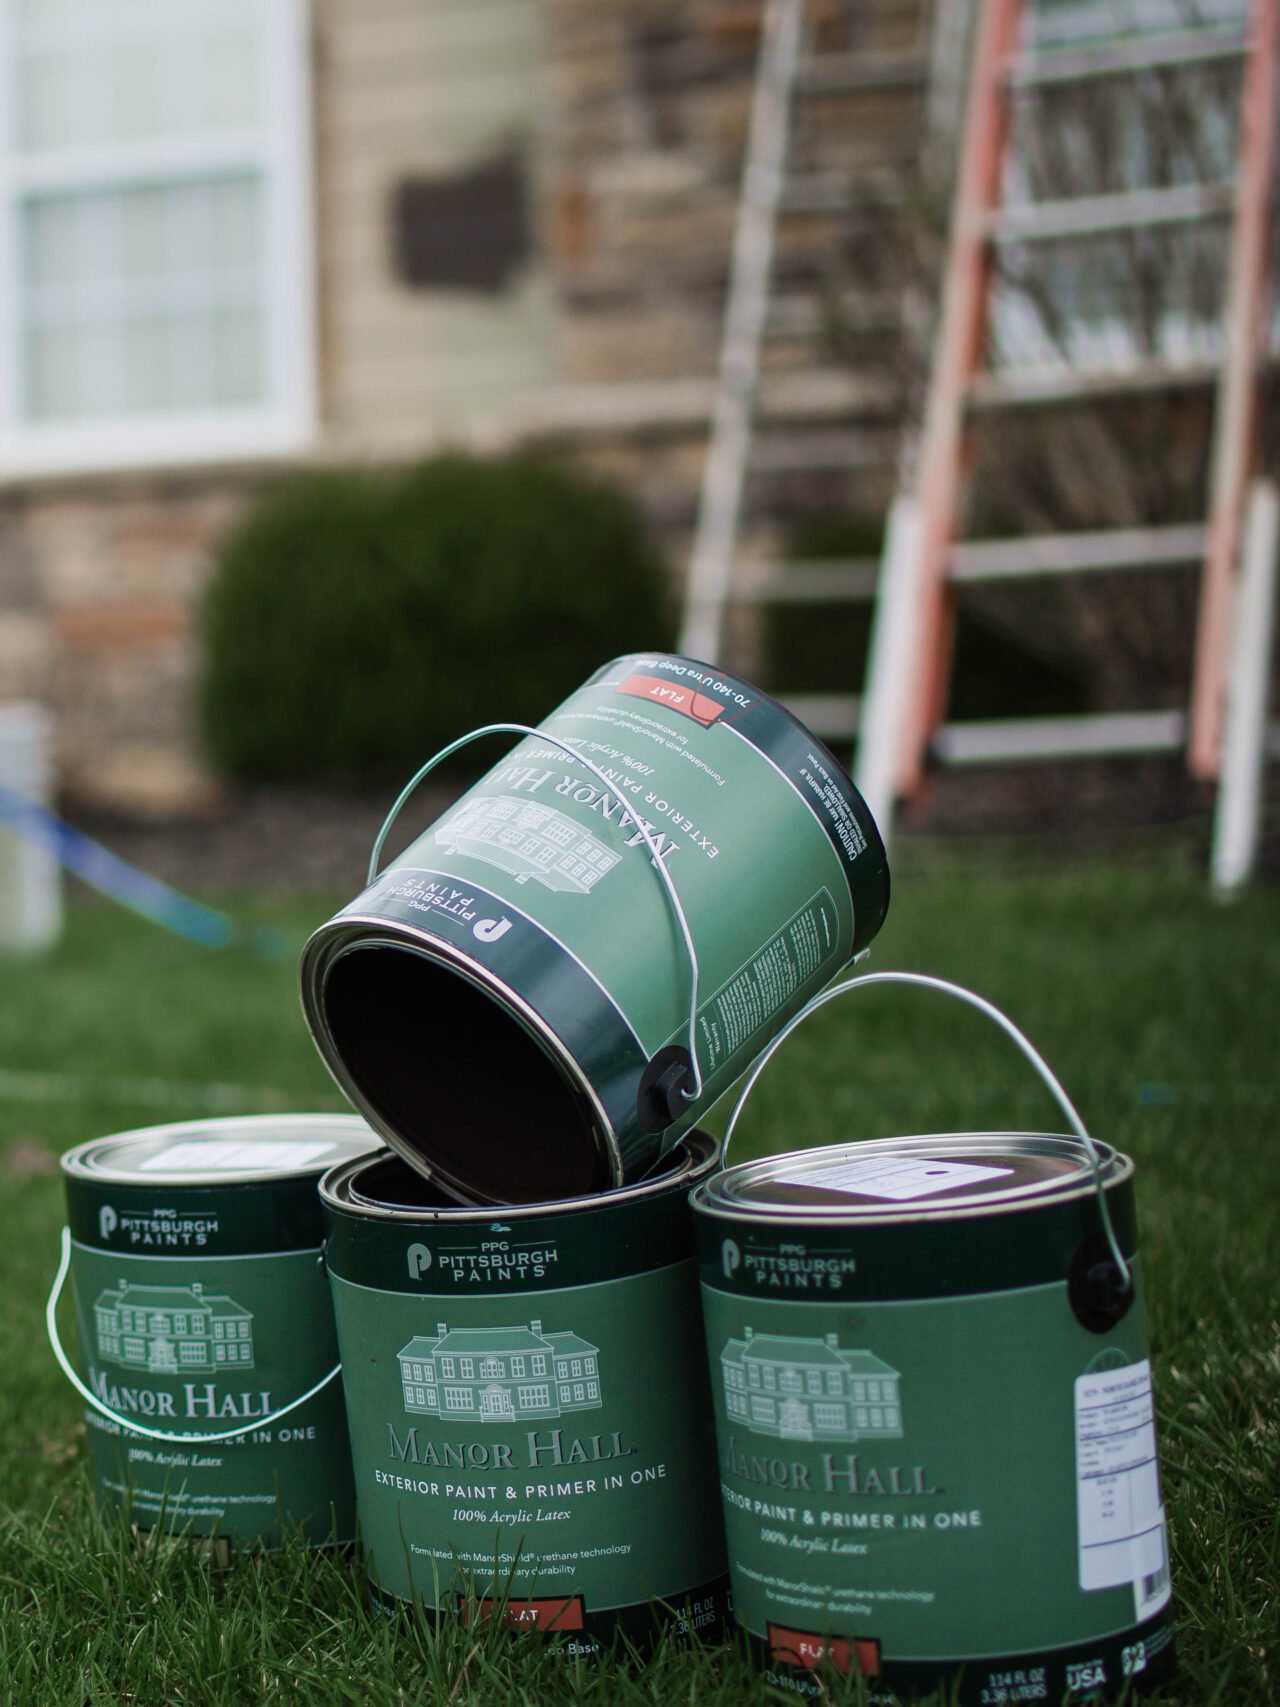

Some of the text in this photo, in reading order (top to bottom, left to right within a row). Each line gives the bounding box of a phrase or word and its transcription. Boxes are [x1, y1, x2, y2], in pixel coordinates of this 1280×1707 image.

[658, 660, 687, 676] Deep
[650, 686, 686, 703] FLAT
[712, 681, 751, 708] 70-140
[665, 742, 682, 755] with
[677, 735, 688, 745] for
[587, 741, 622, 759] Acrylic
[623, 756, 655, 776] 100%
[681, 750, 726, 786] Formulated
[799, 768, 857, 861] CAUTION! MAY BE HARMFUL IF
[644, 791, 719, 859] EXTERIOR
[844, 820, 852, 830] OR
[404, 878, 475, 907] PAINTS
[386, 886, 477, 921] PITTSBURGH
[408, 901, 431, 912] PPG
[153, 1209, 177, 1219] PPG
[121, 1219, 218, 1233] PITTSBURGH
[131, 1232, 208, 1245] PAINTS
[481, 1241, 509, 1252] PPG
[438, 1249, 558, 1268] PITTSBURGH
[779, 1244, 806, 1255] PPG
[745, 1254, 855, 1273] PITTSBURGH
[453, 1265, 545, 1282] PAINTS
[756, 1270, 842, 1288] PAINTS
[183, 1383, 274, 1418] HALL
[253, 1431, 271, 1443] IN
[278, 1426, 317, 1442] ONE
[524, 1429, 633, 1469] HALL
[155, 1452, 190, 1468] Acrylic
[191, 1453, 223, 1467] Latex
[375, 1463, 667, 1499] EXTERIOR PAINT & PRIMER IN ONE
[820, 1454, 937, 1496] HALL
[452, 1508, 572, 1527] 100% Acrylic Latex
[754, 1501, 796, 1523] PAINT
[803, 1510, 815, 1525] &
[821, 1511, 895, 1529] PRIMER
[902, 1514, 926, 1529] IN
[934, 1510, 982, 1529] ONE
[760, 1527, 868, 1554] 100% Acrylic Latex
[580, 1543, 632, 1559] technology
[704, 1597, 714, 1610] OZ
[876, 1589, 936, 1603] technology
[692, 1611, 716, 1629] LITERS
[989, 1667, 1045, 1688] 114 FL OZ
[1066, 1667, 1106, 1691] USA
[980, 1687, 1008, 1704] 3.36
